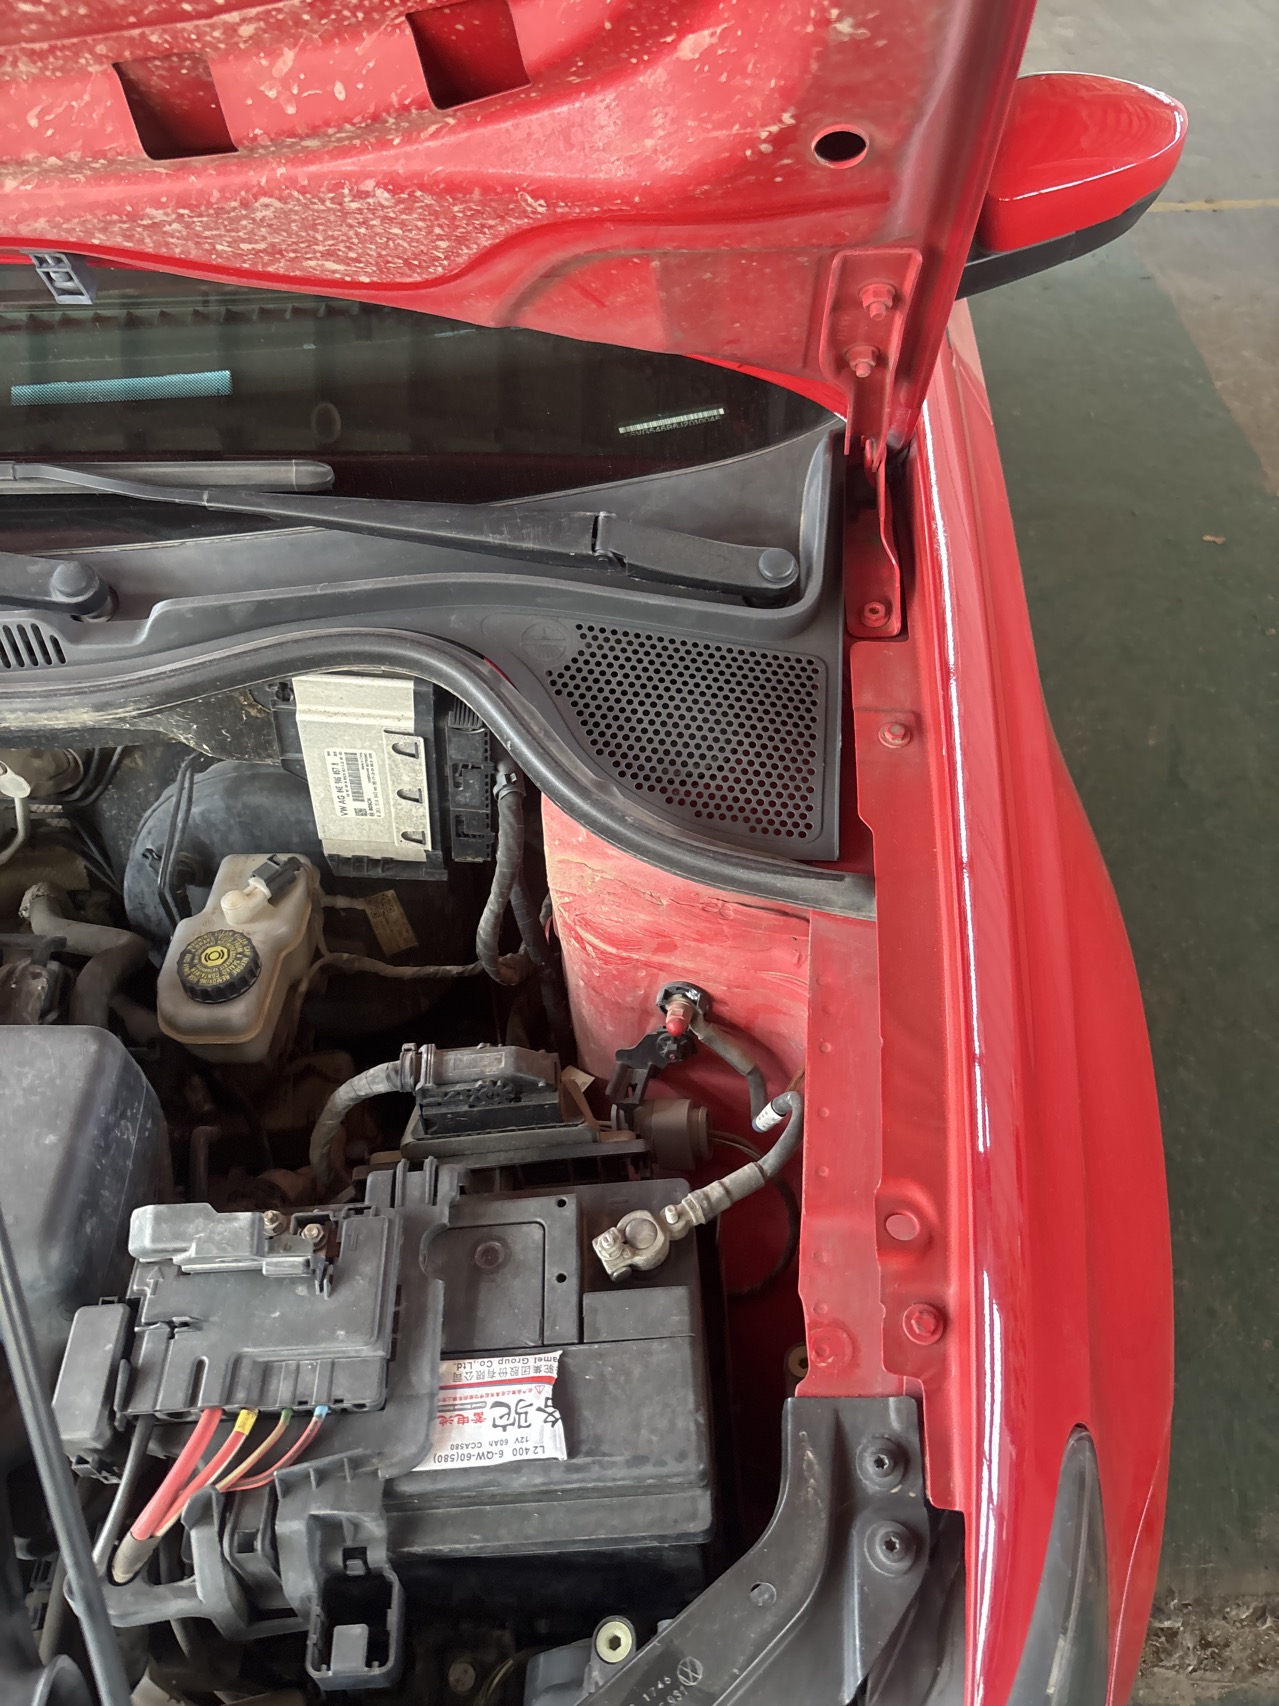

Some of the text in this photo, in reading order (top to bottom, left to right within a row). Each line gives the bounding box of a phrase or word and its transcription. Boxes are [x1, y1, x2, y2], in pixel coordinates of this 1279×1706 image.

[337, 795, 347, 805] AG
[340, 805, 349, 817] VW
[498, 1357, 529, 1365] Group
[534, 1356, 559, 1364] amel
[453, 1364, 558, 1382] 驼集团股份有限公司
[437, 1411, 487, 1426] 蓄电池
[450, 1436, 529, 1451] 12V 60Ah CCA580
[433, 1449, 504, 1464] 6-QW-60(580)
